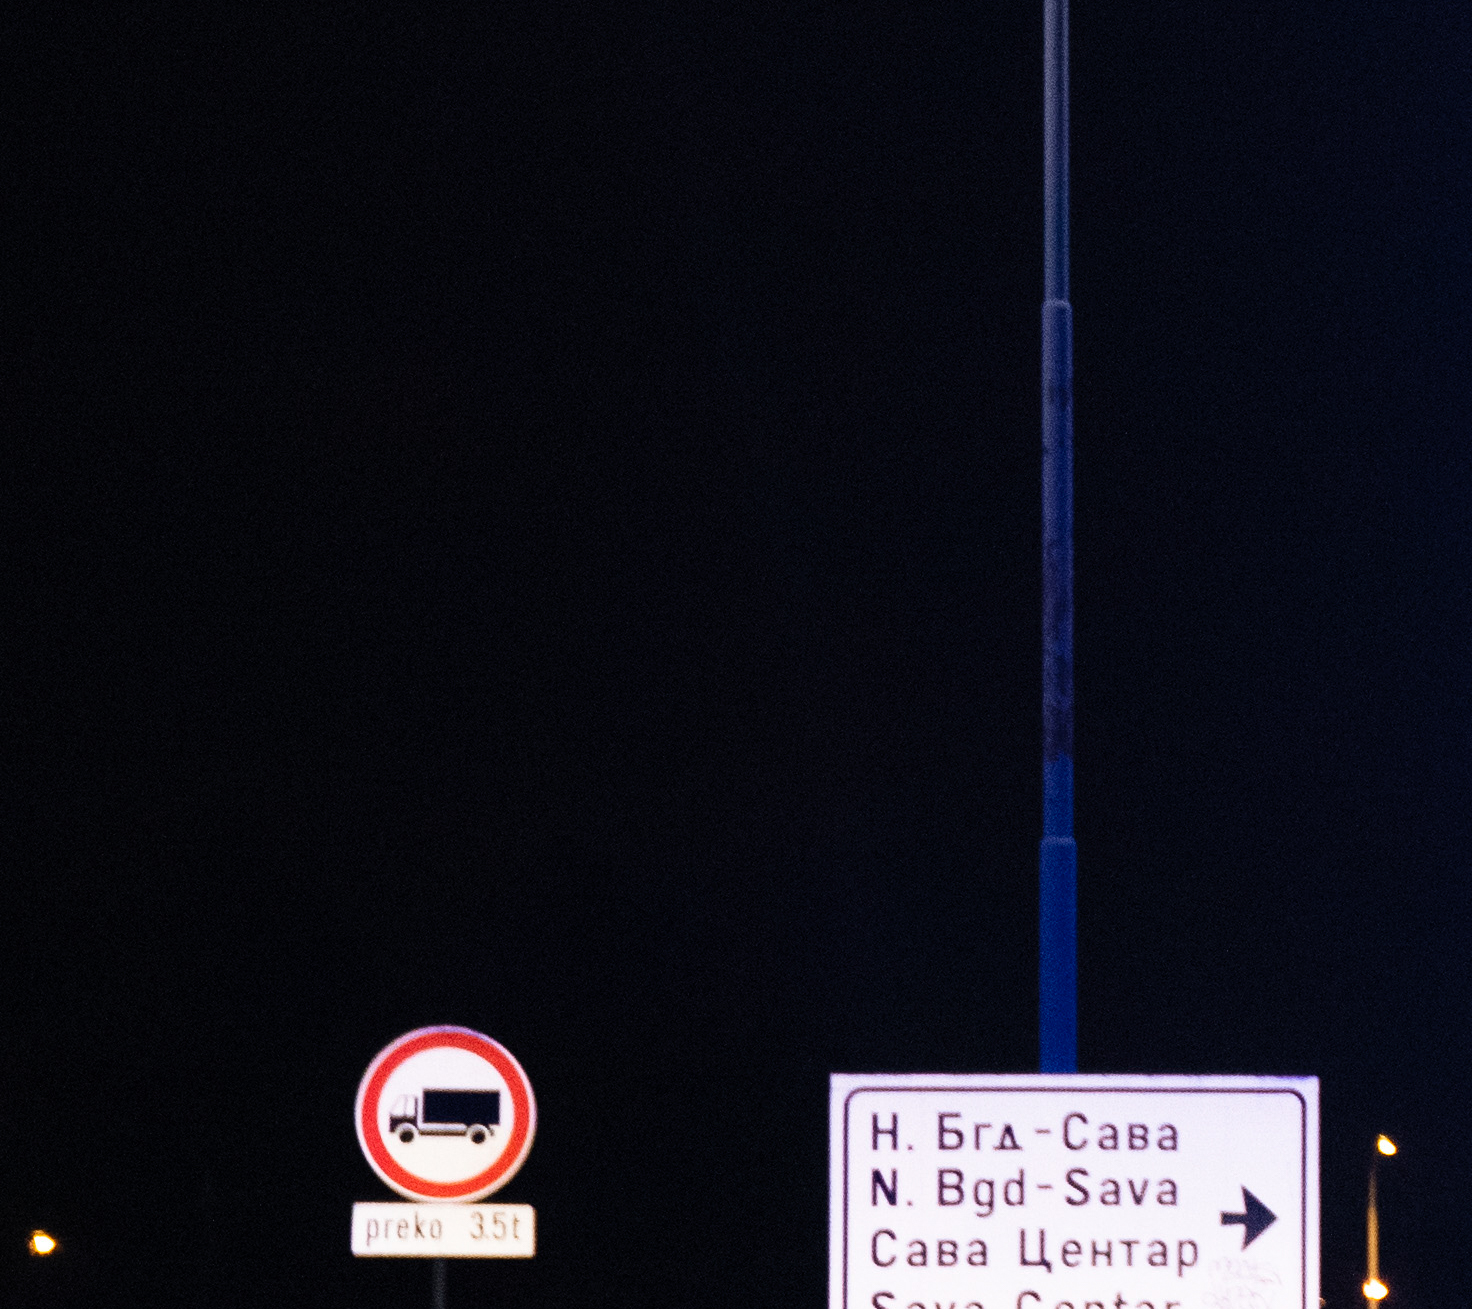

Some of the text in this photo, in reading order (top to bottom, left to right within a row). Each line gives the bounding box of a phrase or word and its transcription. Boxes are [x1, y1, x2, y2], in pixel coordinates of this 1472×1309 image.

[871, 1111, 1179, 1151] Н. Бгд-Сава
[871, 1167, 1179, 1218] N. Bgd-Sava
[366, 1210, 443, 1247] preko
[871, 1228, 1199, 1278] Сава Центар
